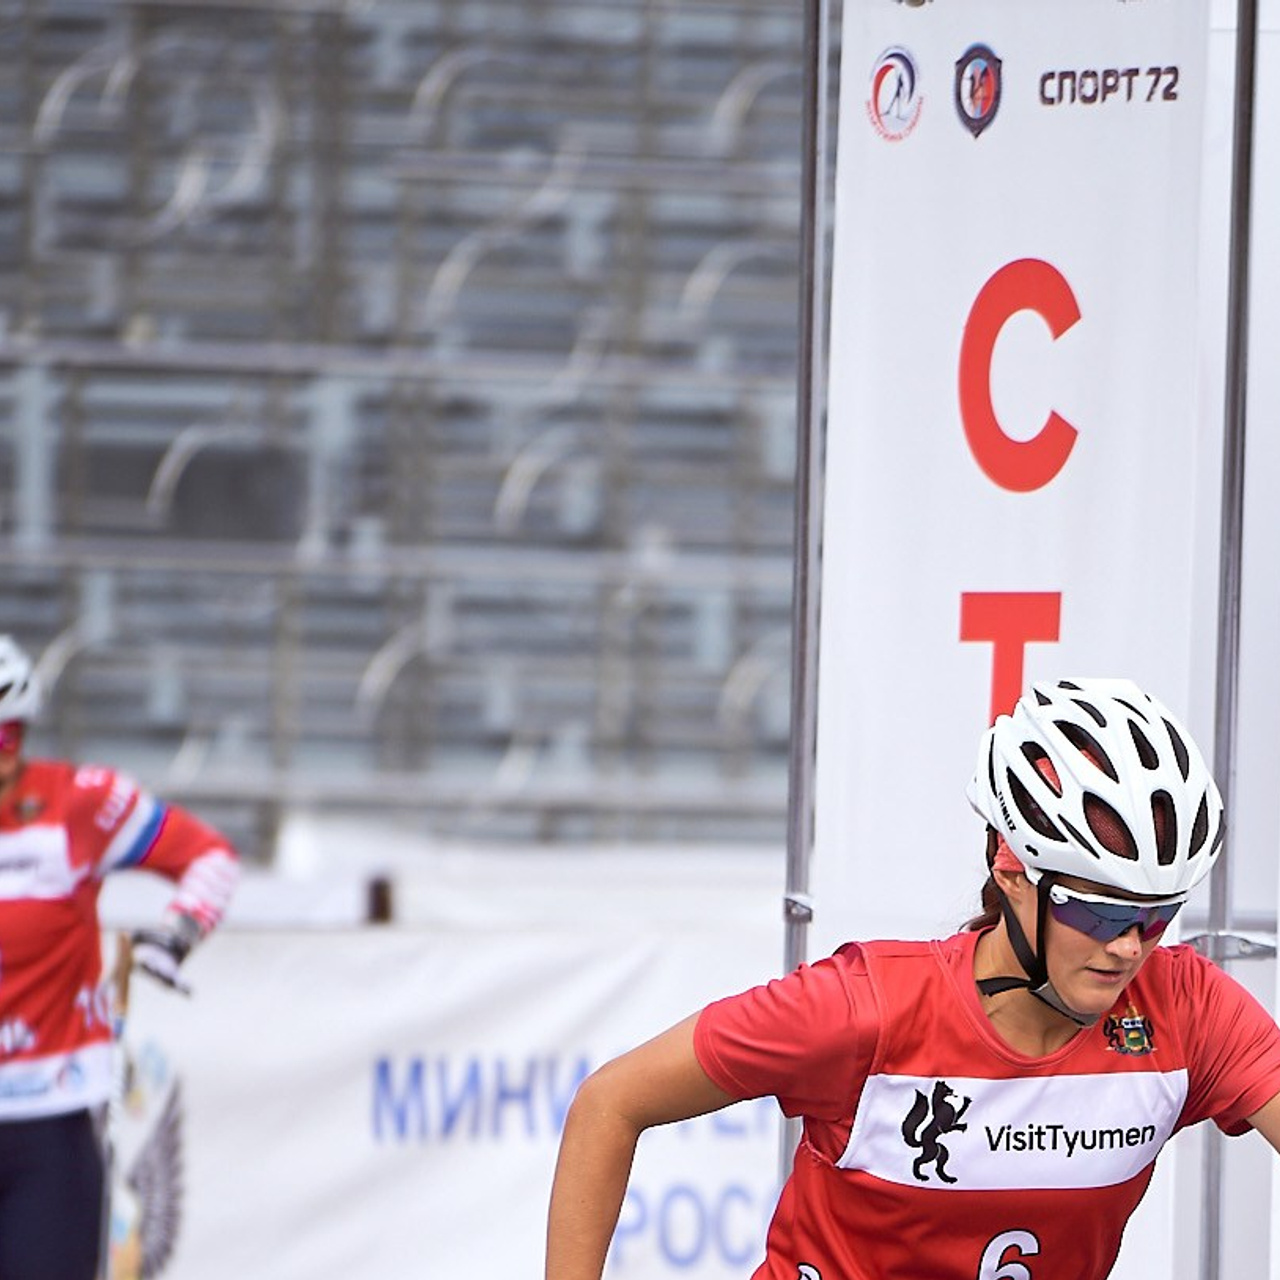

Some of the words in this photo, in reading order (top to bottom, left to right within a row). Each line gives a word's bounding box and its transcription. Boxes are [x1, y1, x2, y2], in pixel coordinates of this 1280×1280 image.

[1040, 67, 1139, 106] СПОРТ
[1146, 66, 1179, 102] 72
[984, 1123, 1157, 1158] VisitTyumen
